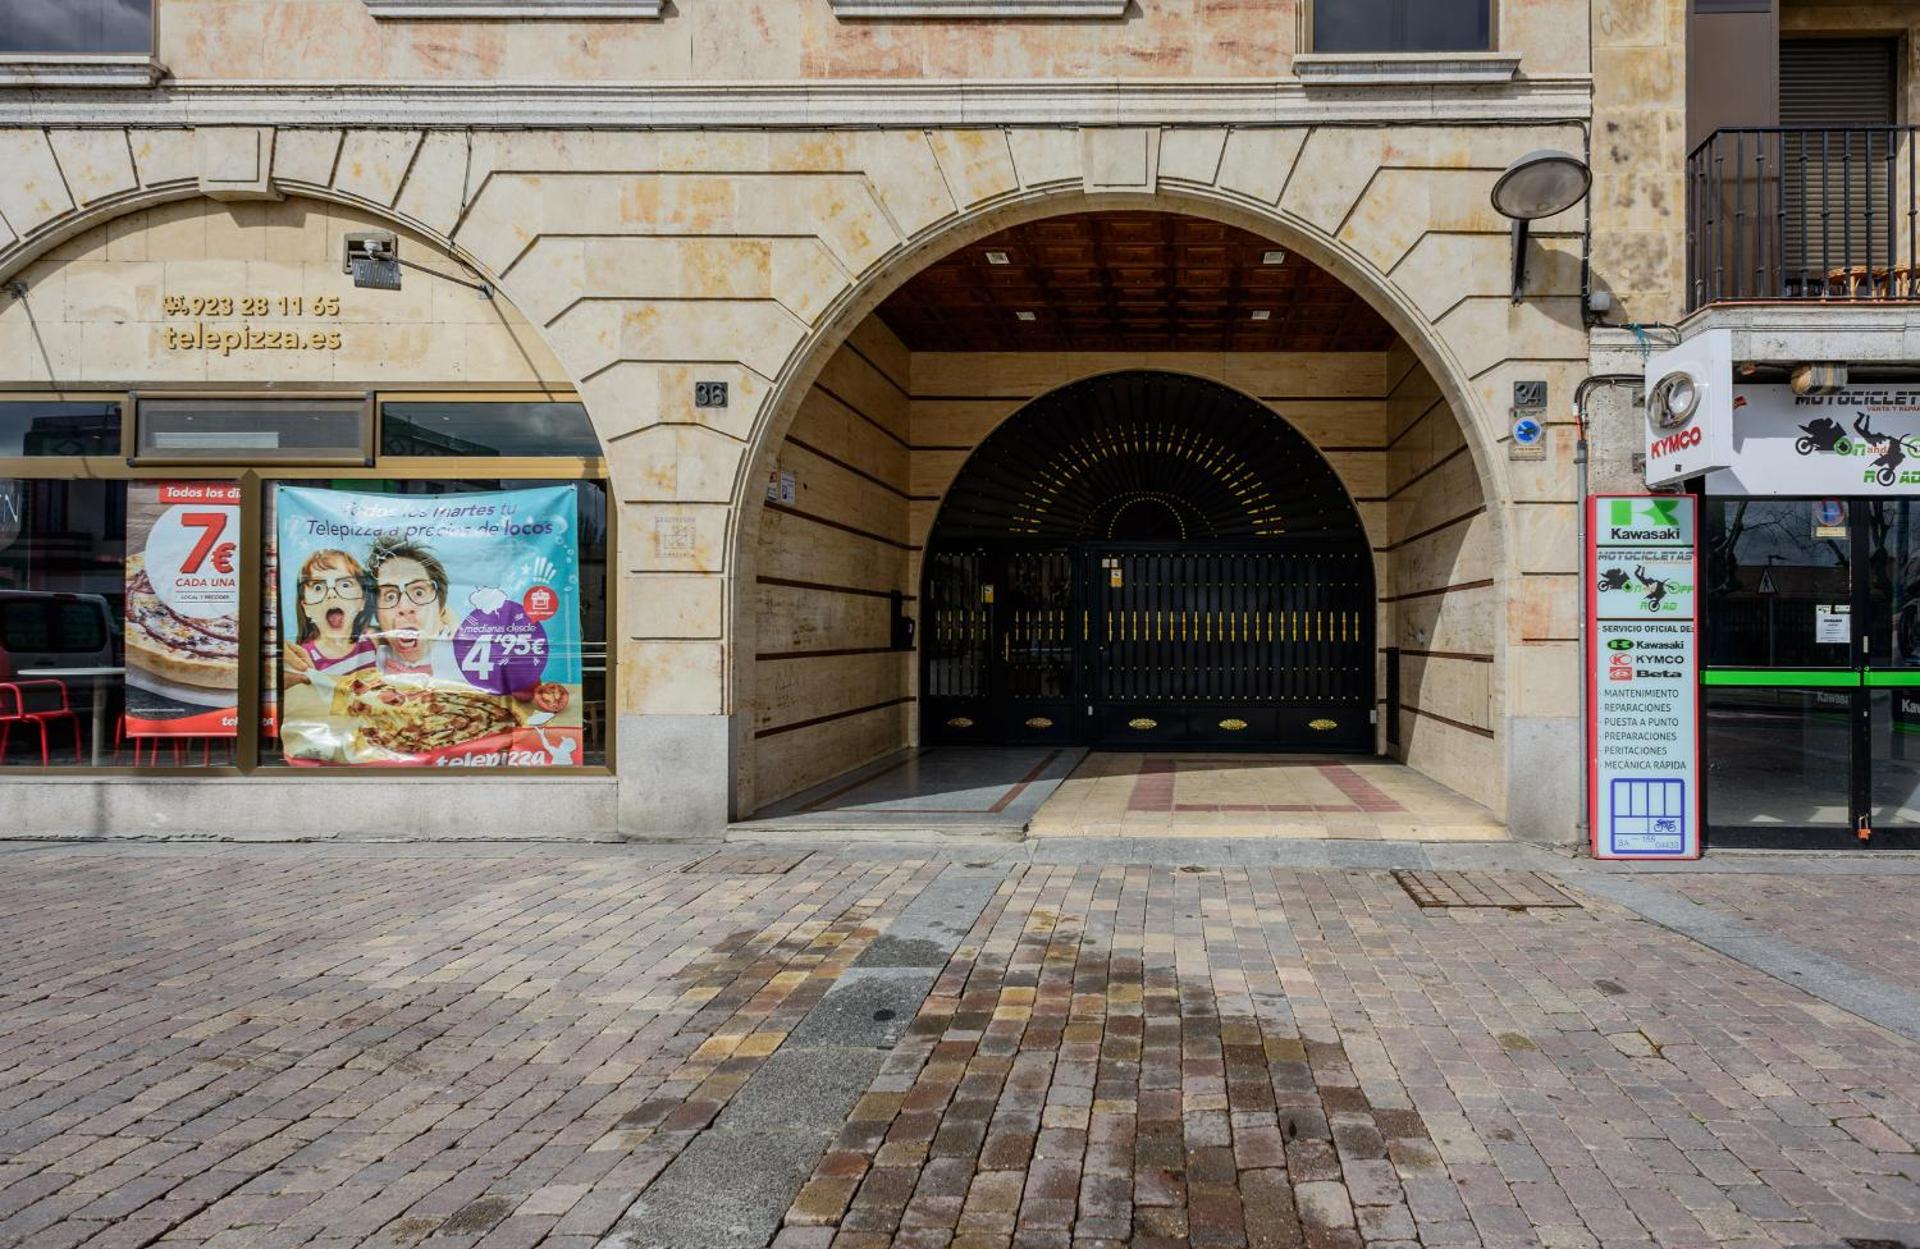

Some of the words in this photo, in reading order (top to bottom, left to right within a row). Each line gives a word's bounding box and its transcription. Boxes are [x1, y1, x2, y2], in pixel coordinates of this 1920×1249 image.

[193, 296, 233, 316] 923
[241, 296, 269, 316] 28
[277, 296, 303, 316] 11
[312, 296, 340, 316] 65
[167, 323, 342, 357] telepizza.es
[697, 384, 727, 405] 36
[1651, 426, 1702, 460] KYMCO
[167, 487, 202, 498] Todos
[206, 487, 224, 498] los
[504, 519, 553, 536] locos
[1611, 528, 1680, 540] Kawasaki
[180, 513, 237, 574] 7€
[1598, 550, 1695, 561] MOTOCICLETAS
[175, 578, 207, 587] CADA
[211, 578, 236, 587] UNA
[463, 624, 505, 633] medianas
[507, 622, 536, 633] desde
[1602, 625, 1642, 633] SERVICIO
[1644, 625, 1678, 633] OFICIAL
[1636, 640, 1684, 650] Kawasaki
[1636, 655, 1684, 664] KYMCO
[1636, 670, 1682, 678] Beta
[1604, 689, 1679, 698] MANTENIMIENTO
[1604, 703, 1672, 712] REPARACIONES
[1604, 717, 1638, 726] PUESTA
[1640, 717, 1646, 726] A
[1648, 717, 1679, 726] PUNTO
[1604, 731, 1677, 741] PREPARACIONES
[1604, 746, 1668, 755] PERITACIONES
